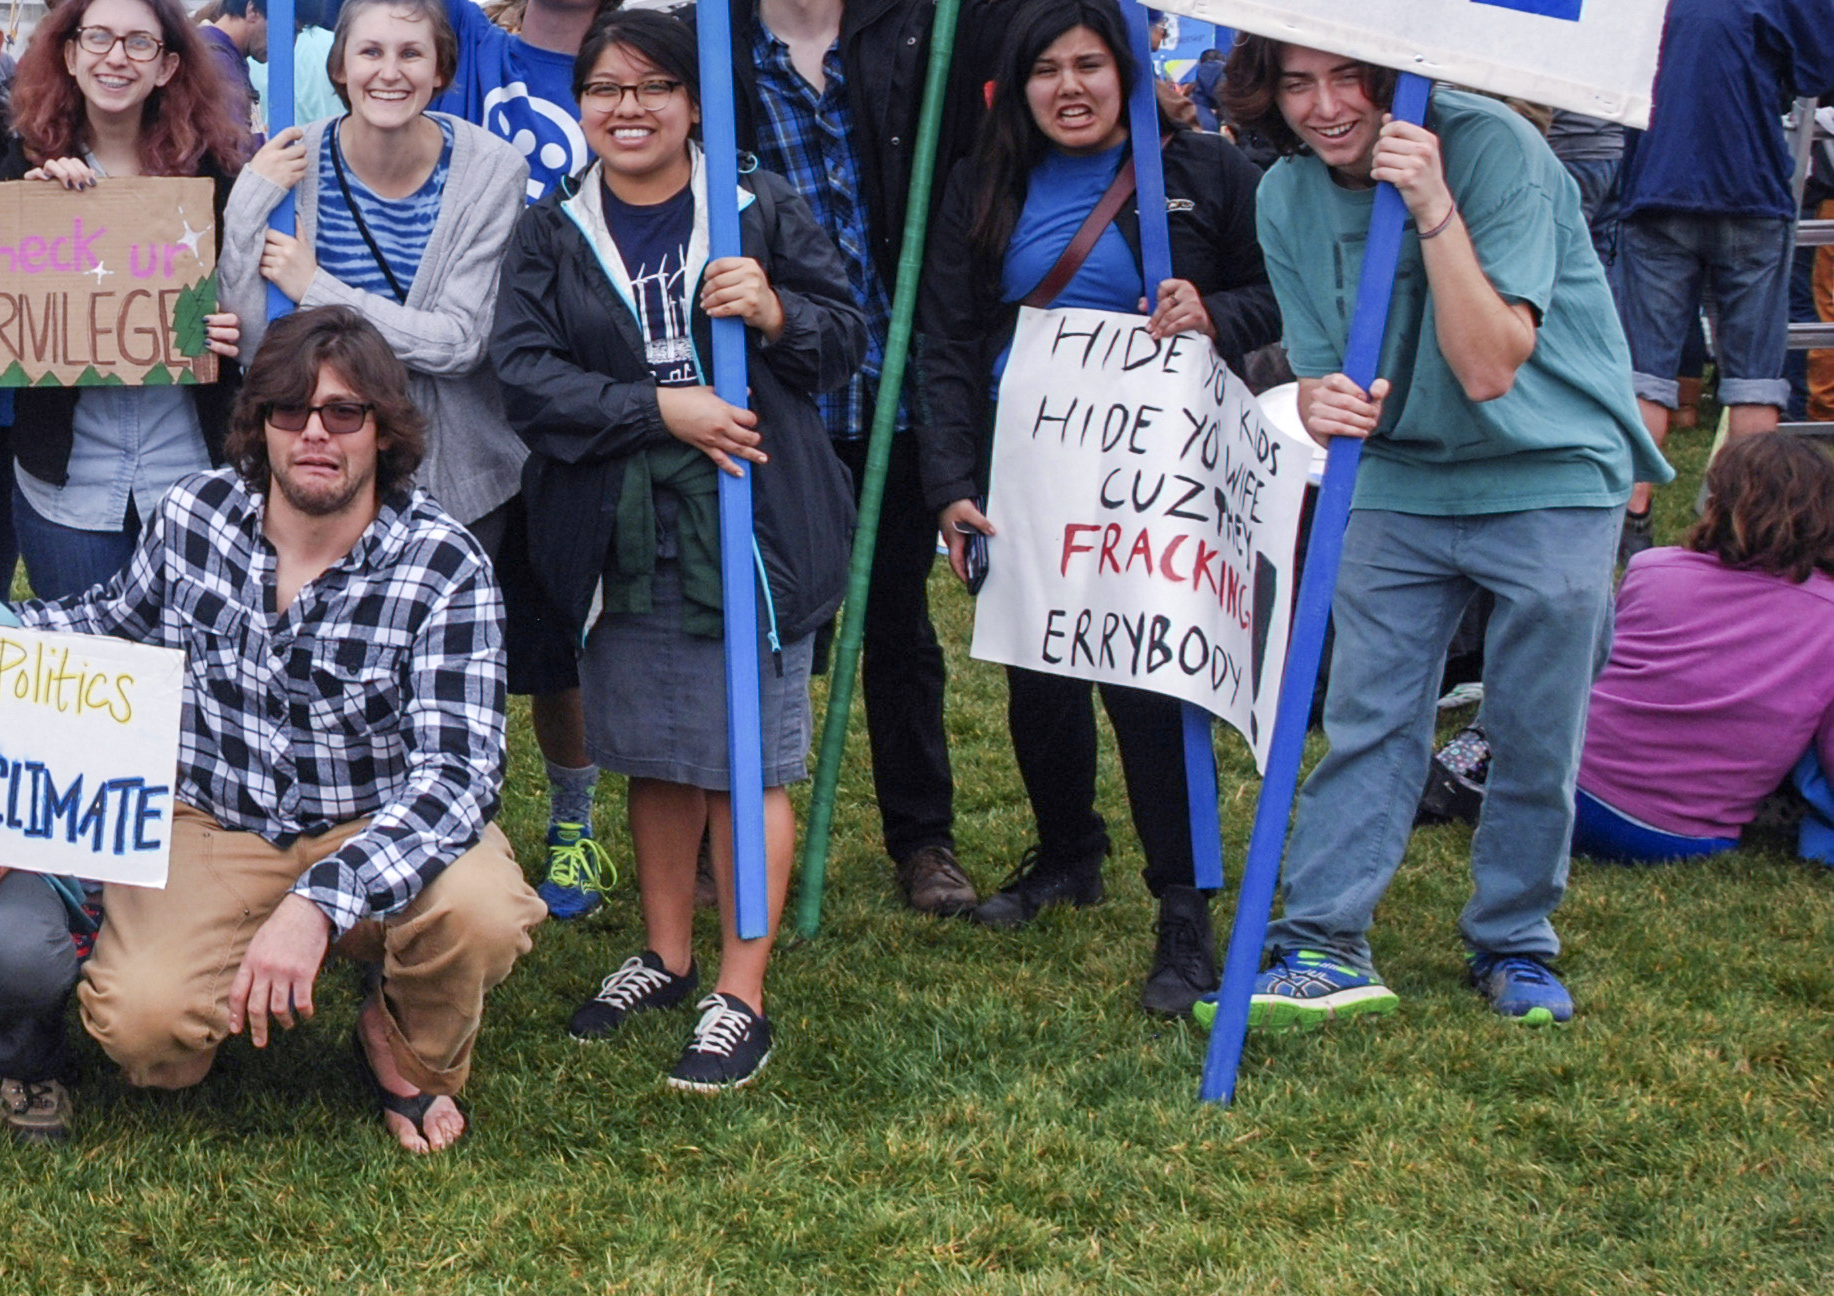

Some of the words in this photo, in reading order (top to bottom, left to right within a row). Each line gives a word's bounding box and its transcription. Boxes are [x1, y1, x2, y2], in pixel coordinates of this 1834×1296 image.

[129, 241, 192, 279] ur
[1051, 316, 1198, 374] HIDE
[1239, 404, 1282, 477] KIDS
[1032, 395, 1164, 455] HIDE
[1224, 445, 1267, 523] WIFE
[1100, 467, 1209, 523] CUZ
[1213, 485, 1252, 572] THEY
[1060, 522, 1252, 631] FRACKING
